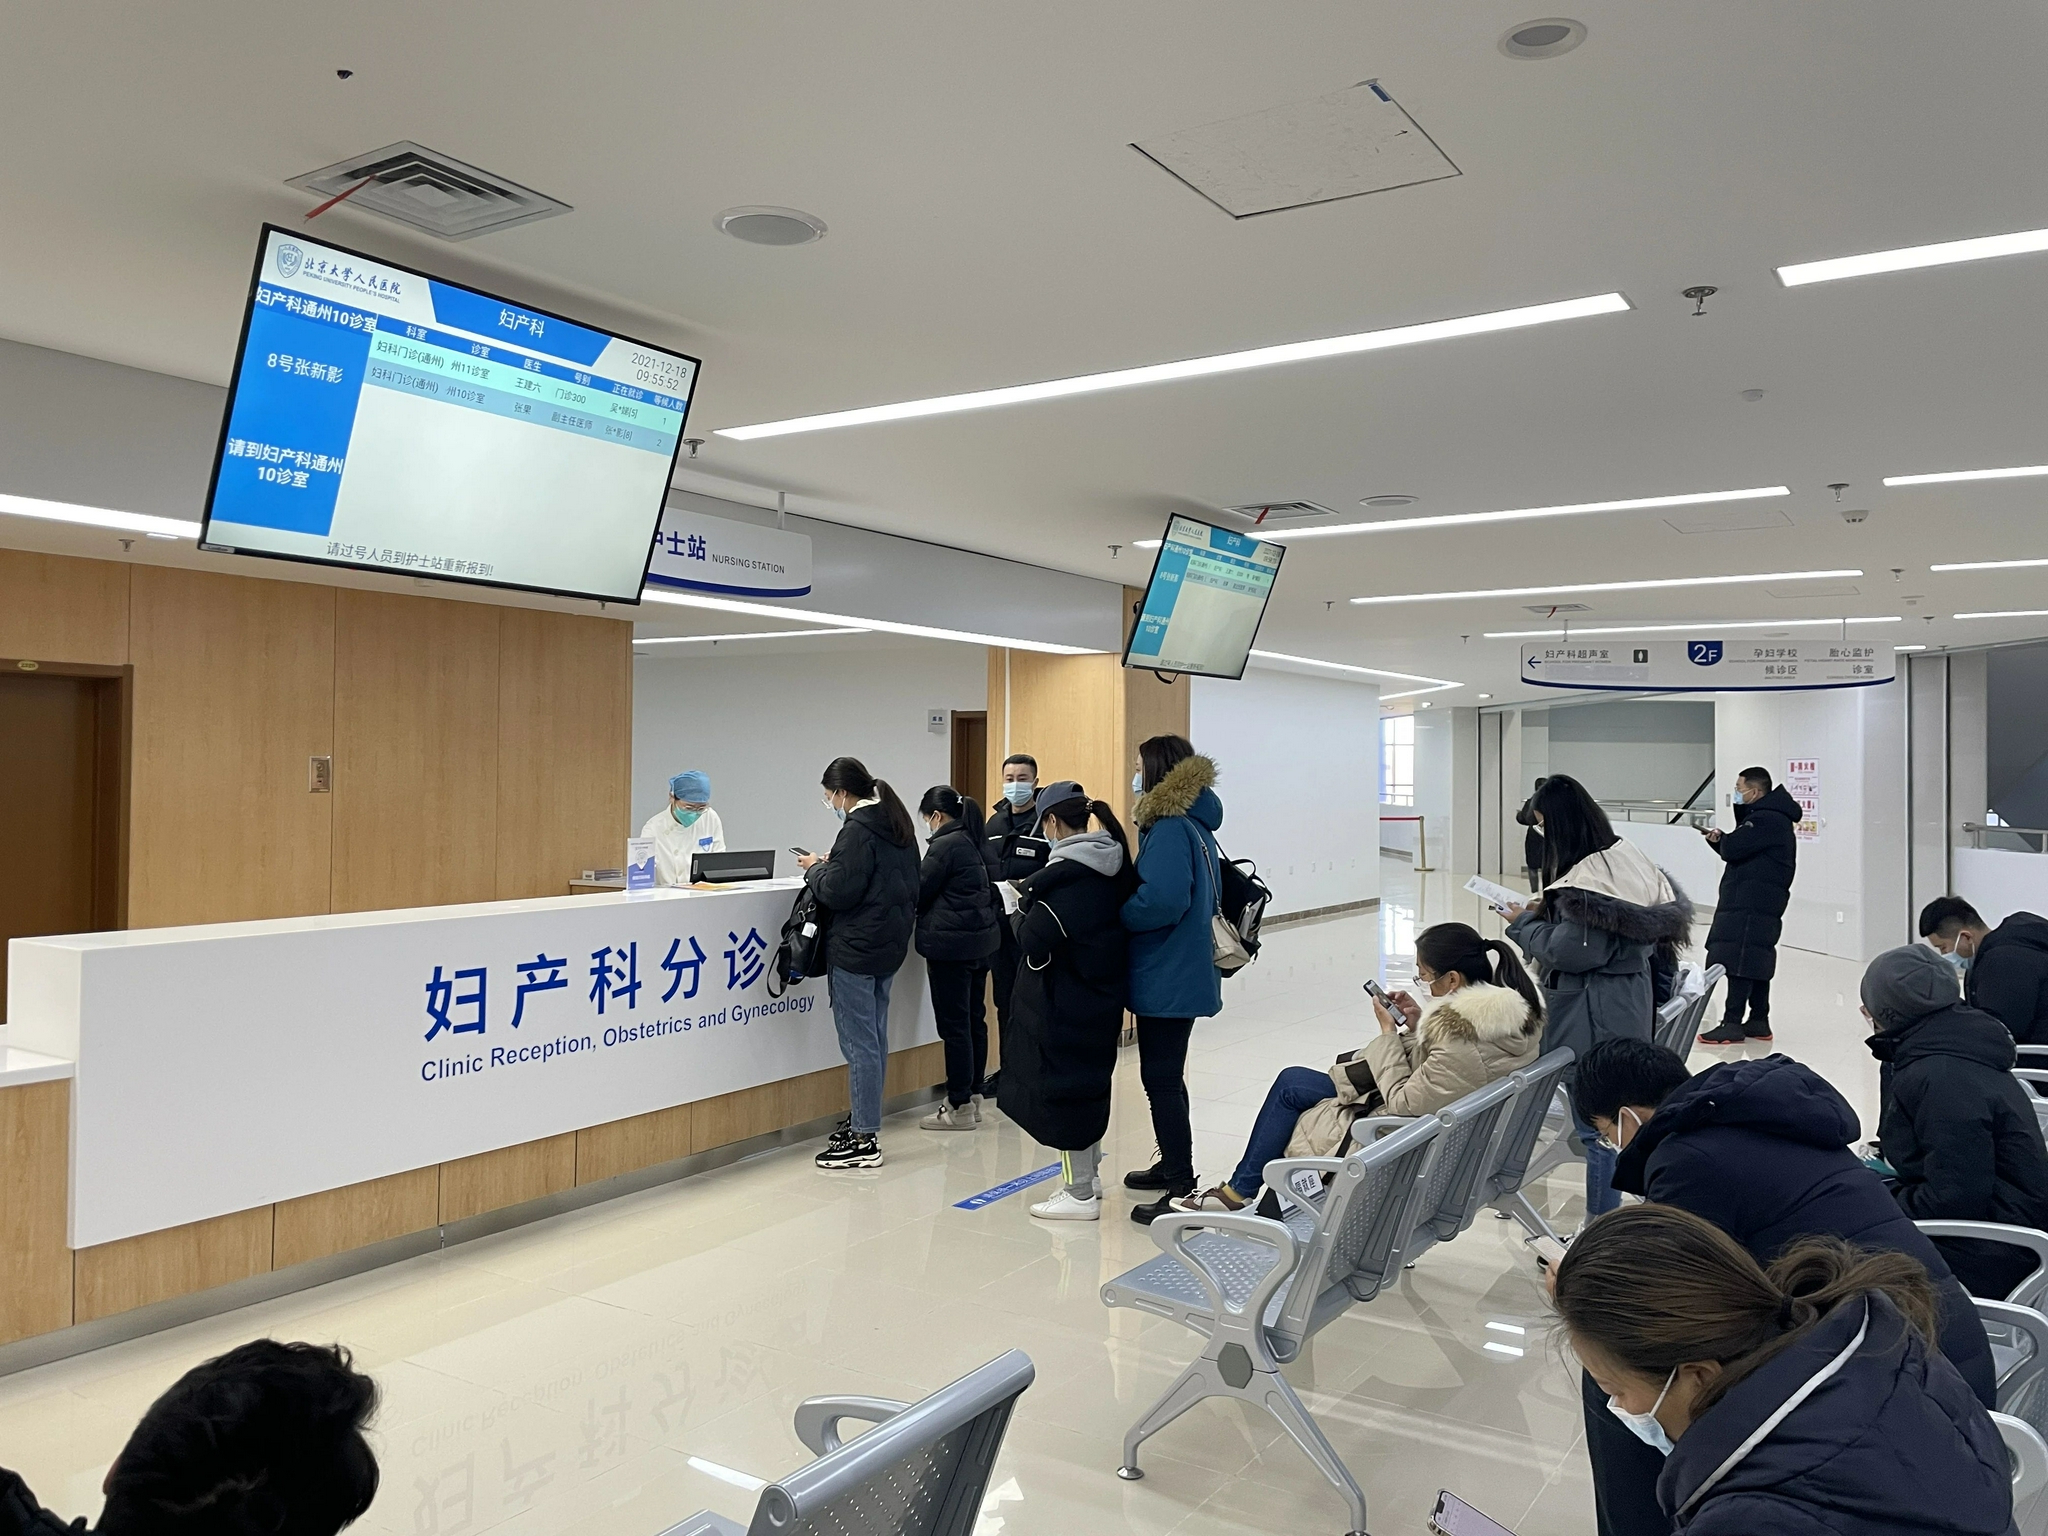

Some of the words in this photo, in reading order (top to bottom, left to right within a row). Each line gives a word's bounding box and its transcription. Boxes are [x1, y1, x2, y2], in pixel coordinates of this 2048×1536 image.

[302, 271, 323, 281] PEKING
[323, 276, 352, 289] UNIVERSITY
[352, 284, 377, 297] PEOPLE'S
[377, 291, 401, 304] HOSPITAL
[304, 257, 402, 295] 北京大学人民医院
[255, 286, 377, 333] 妇产科通州10诊室
[498, 308, 545, 338] 妇产科
[267, 353, 344, 384] 8号张新影
[376, 340, 445, 369] 妇科门诊(通州)
[450, 360, 491, 380] 州11诊室
[405, 325, 428, 341] 科室
[471, 343, 491, 358] 诊室
[523, 358, 543, 373] 医生
[574, 372, 591, 386] 号别
[631, 352, 688, 379] 2021-12-18
[371, 366, 440, 395] 妇科门诊(通州)
[446, 386, 486, 404] 州10诊室
[636, 369, 679, 391] 09:55:52
[228, 438, 345, 475] 请到妇产科通州
[257, 467, 310, 488] 10诊室
[326, 541, 494, 577] 请过号人员到护士站重新报到!
[712, 553, 751, 569] NURSING
[751, 560, 785, 574] STATION
[1545, 649, 1609, 659] 妇产科超声室
[1693, 643, 1718, 663] 2F
[1753, 648, 1798, 658] 孕妇学校
[1829, 648, 1874, 658] 胎心监护
[1765, 665, 1798, 675] 候诊区
[1853, 664, 1874, 674] 诊室
[424, 927, 768, 1043] 妇产科分诊
[421, 1054, 484, 1082] Clinic
[490, 1032, 597, 1068] Reception,
[603, 1016, 692, 1048] Obstetrics
[698, 1008, 727, 1029] and
[731, 992, 815, 1025] Gynecology
